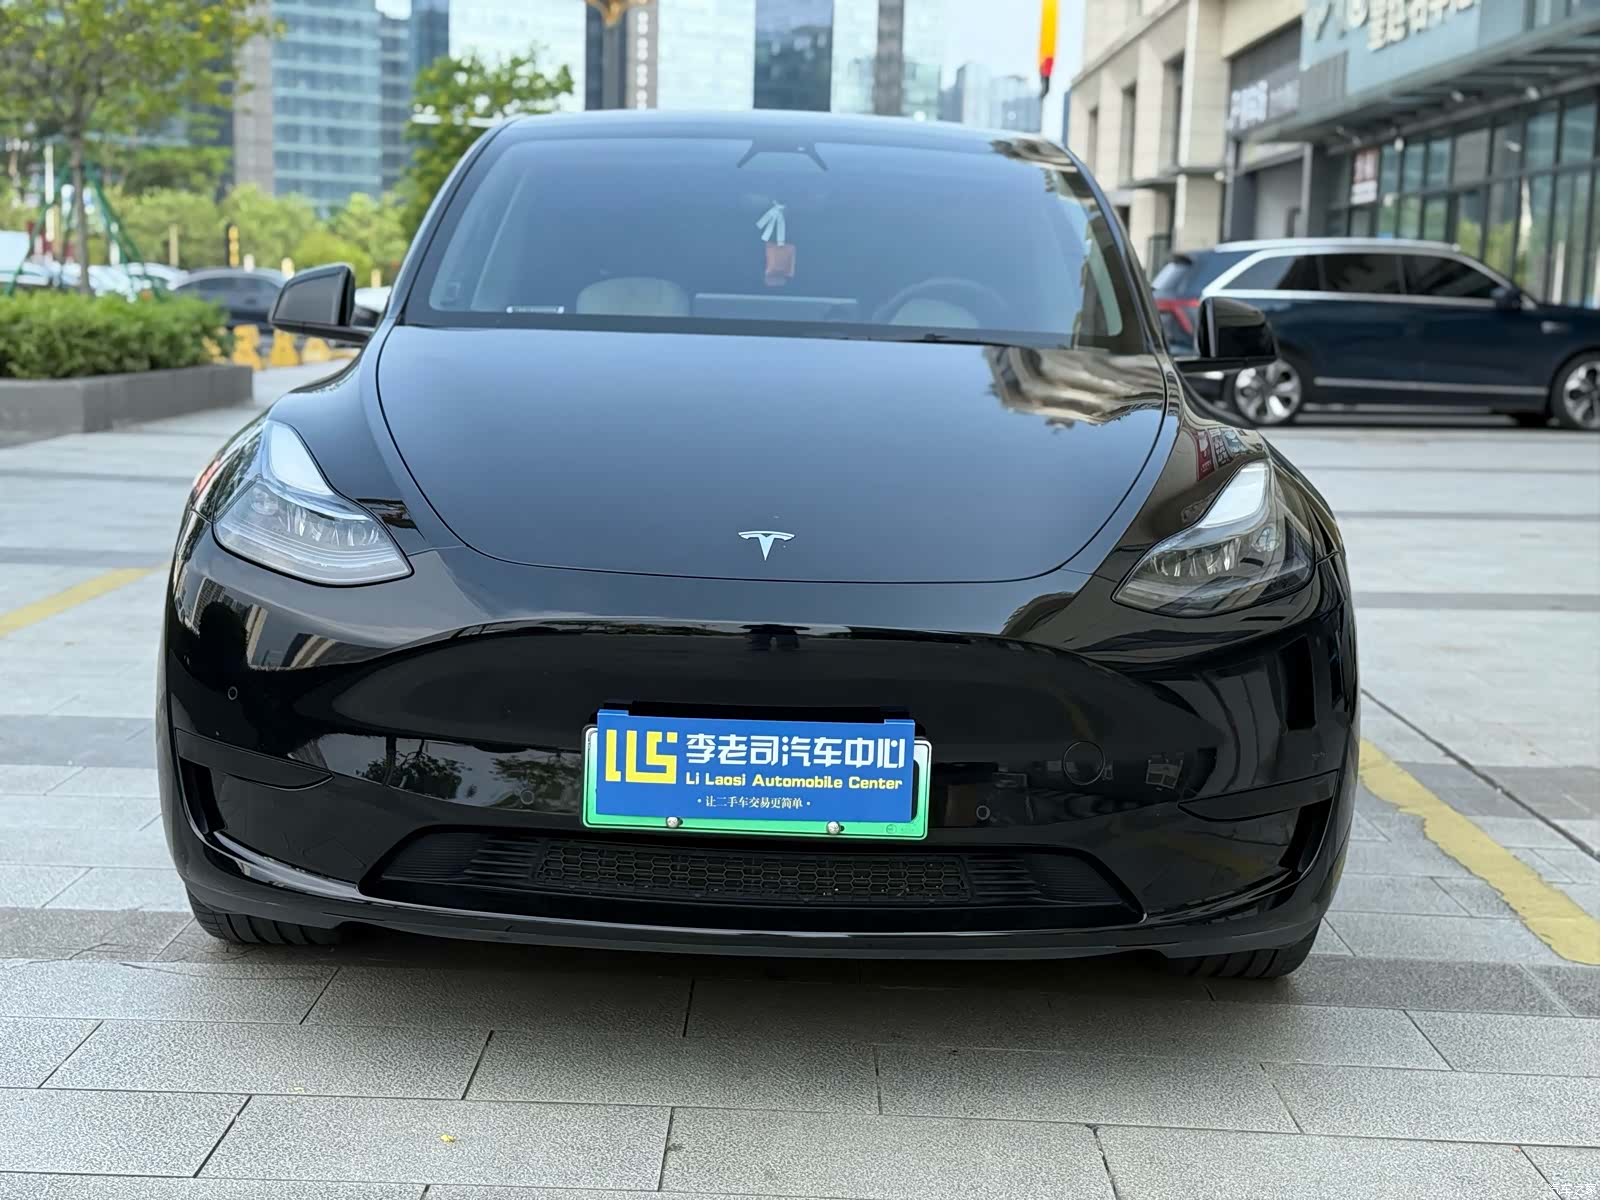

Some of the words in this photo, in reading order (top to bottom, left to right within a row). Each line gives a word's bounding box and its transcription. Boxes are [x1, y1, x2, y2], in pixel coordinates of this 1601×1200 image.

[685, 733, 906, 769] 李老司汽车中心
[685, 772, 700, 785] Li
[705, 773, 747, 787] Laosi
[751, 775, 843, 789] Automobile
[848, 776, 903, 790] Center
